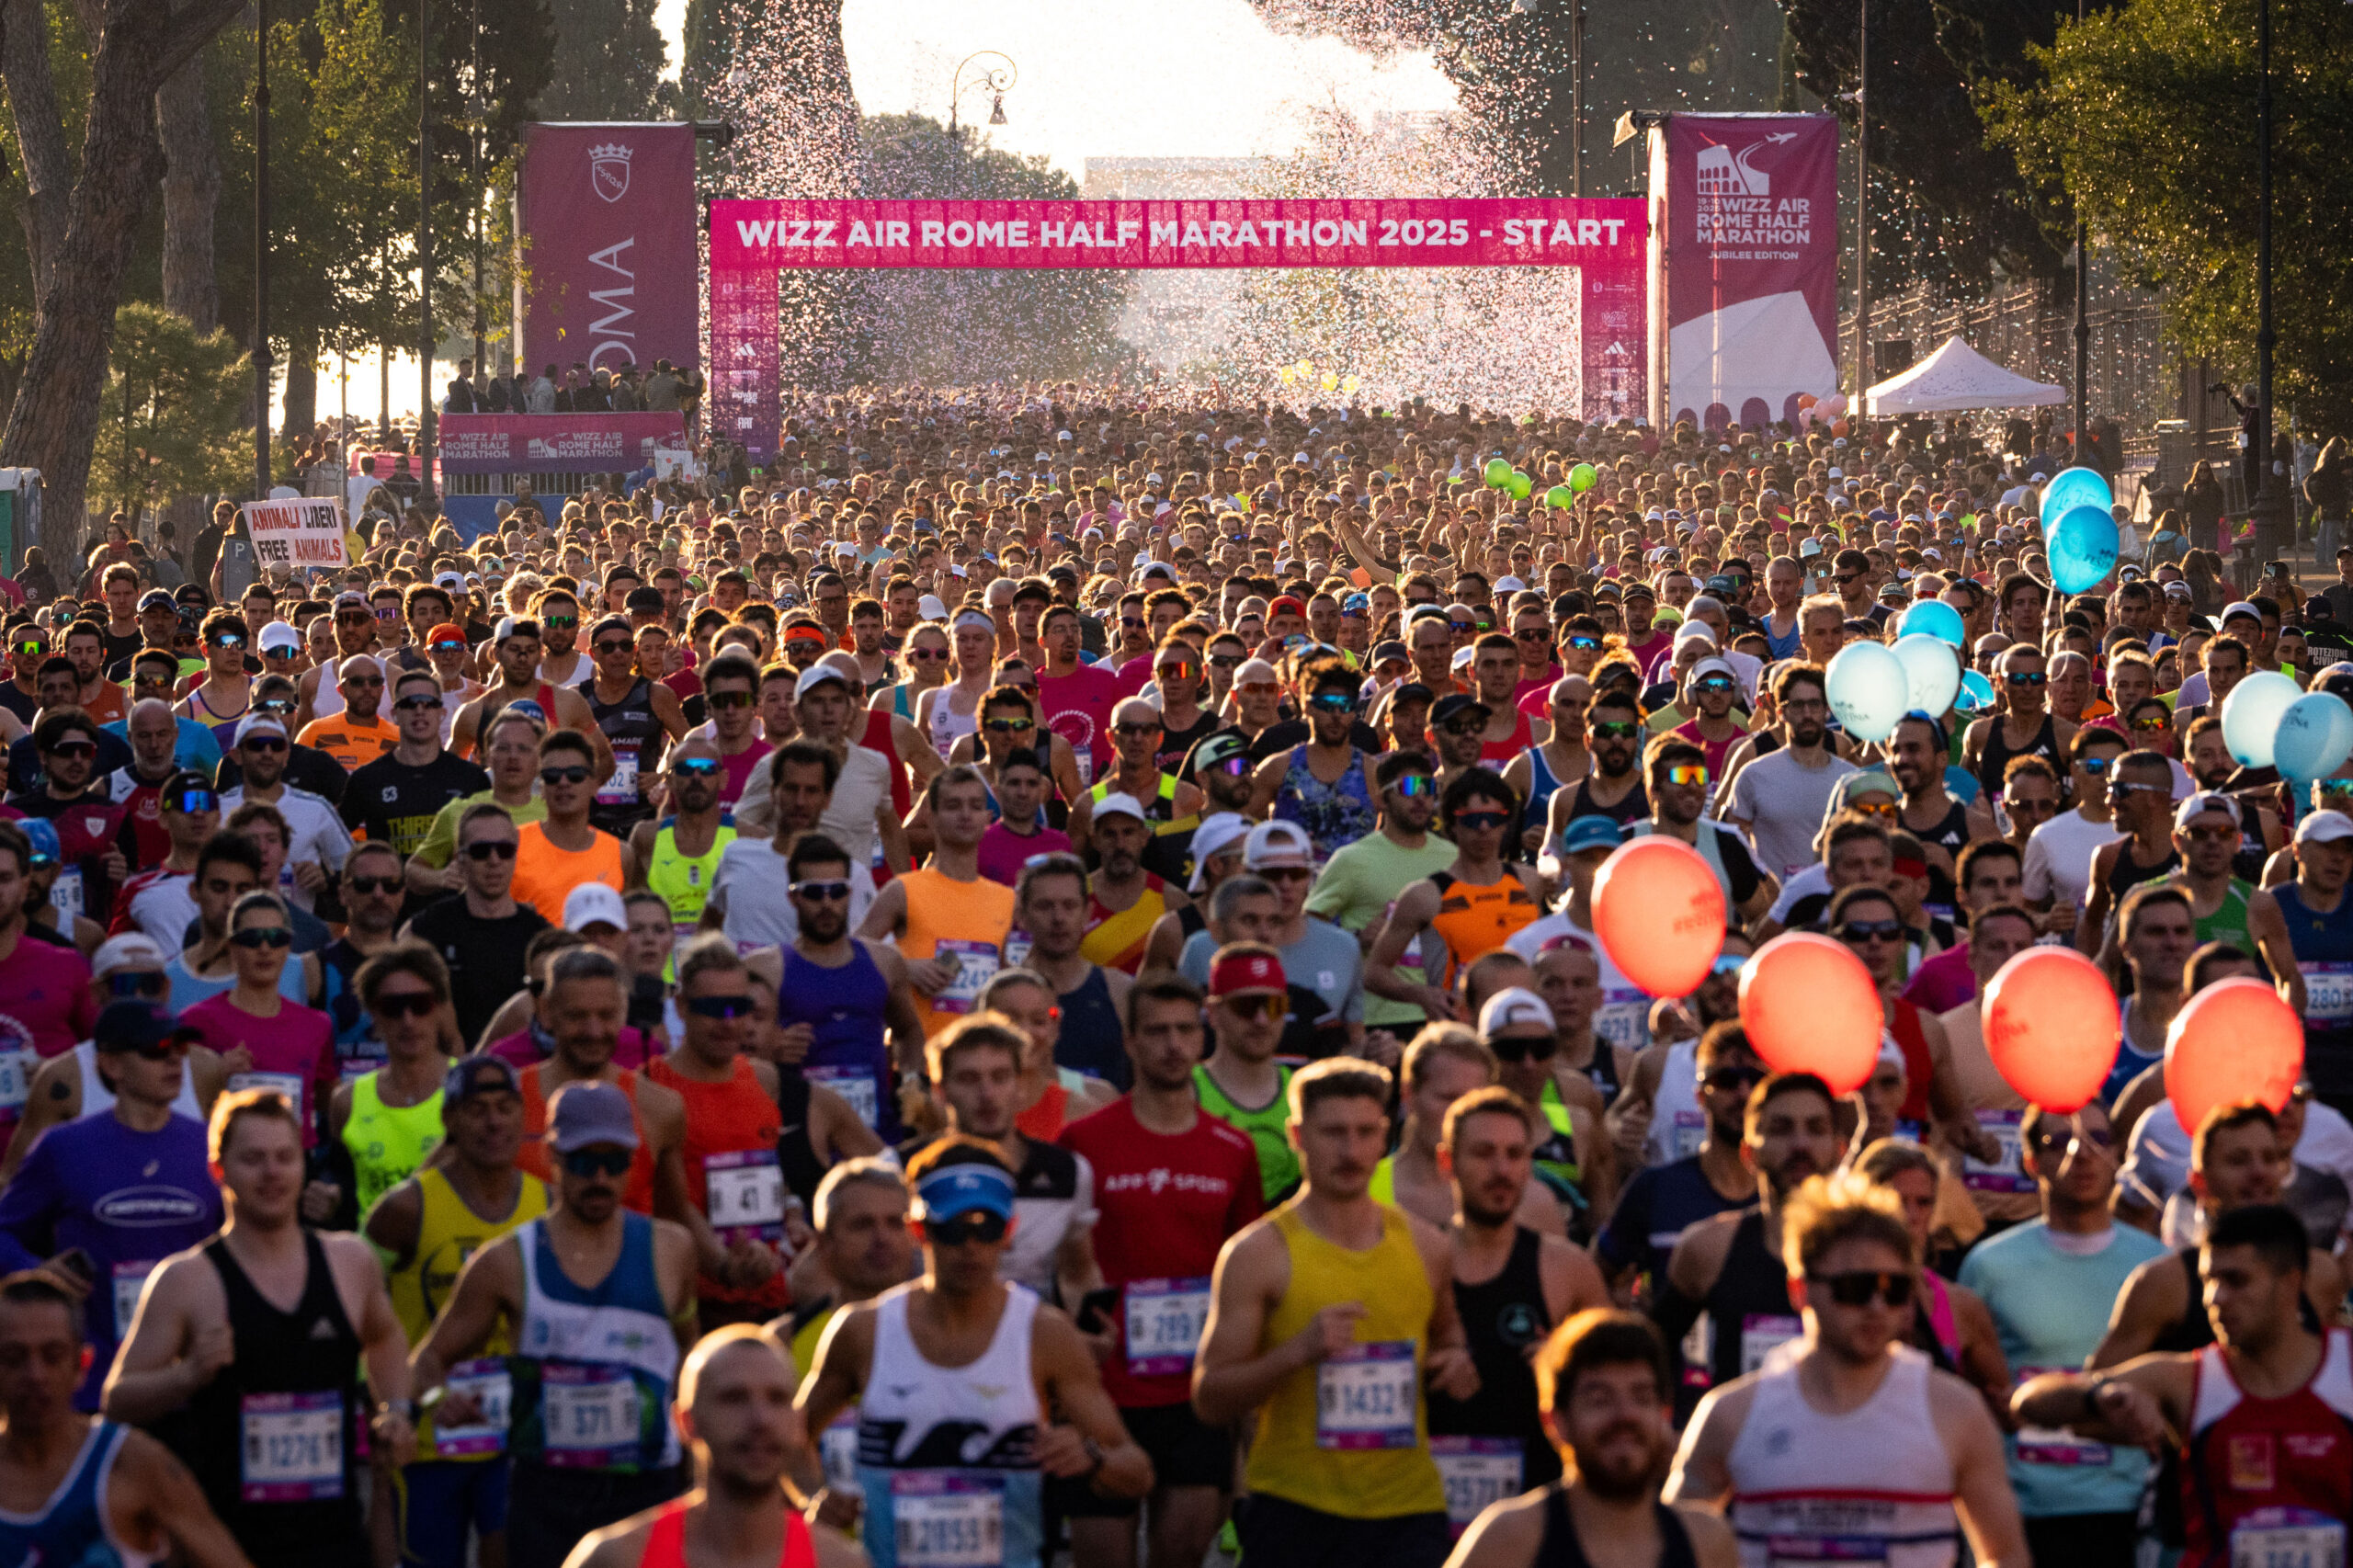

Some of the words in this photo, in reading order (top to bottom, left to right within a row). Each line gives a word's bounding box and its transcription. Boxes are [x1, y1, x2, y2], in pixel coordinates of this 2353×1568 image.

[1721, 198, 1771, 212] WIZZ
[1777, 198, 1810, 212] AIR
[1697, 213, 1753, 228] ROME
[1758, 214, 1810, 229] HALF
[736, 221, 836, 247] WIZZ
[847, 221, 911, 247] AIR
[922, 221, 1029, 247] ROME
[1040, 221, 1139, 247] HALF
[1150, 220, 1367, 247] MARATHON
[1379, 220, 1469, 246] 2025
[1504, 219, 1625, 246] START
[1697, 229, 1810, 244] MARATHON
[1708, 251, 1752, 259] JUBILEE
[1755, 251, 1799, 260] EDITION
[588, 236, 636, 375] OMA
[738, 417, 754, 430] FIAT
[460, 433, 487, 441] WIZZ
[491, 433, 509, 441] AIR
[572, 433, 600, 441] WIZZ
[604, 433, 623, 442] AIR
[445, 441, 477, 450] ROME
[483, 442, 509, 450] HALF
[558, 441, 590, 450] ROME
[596, 441, 623, 450] HALF
[445, 449, 510, 460] MARATHON
[558, 449, 624, 459] MARATHON
[252, 506, 301, 531] ANIMALI
[303, 506, 337, 528] LIBERI
[235, 543, 245, 557] P
[257, 540, 290, 561] FREE
[295, 539, 342, 561] ANIMALS
[2308, 646, 2348, 659] ROTEZIONE
